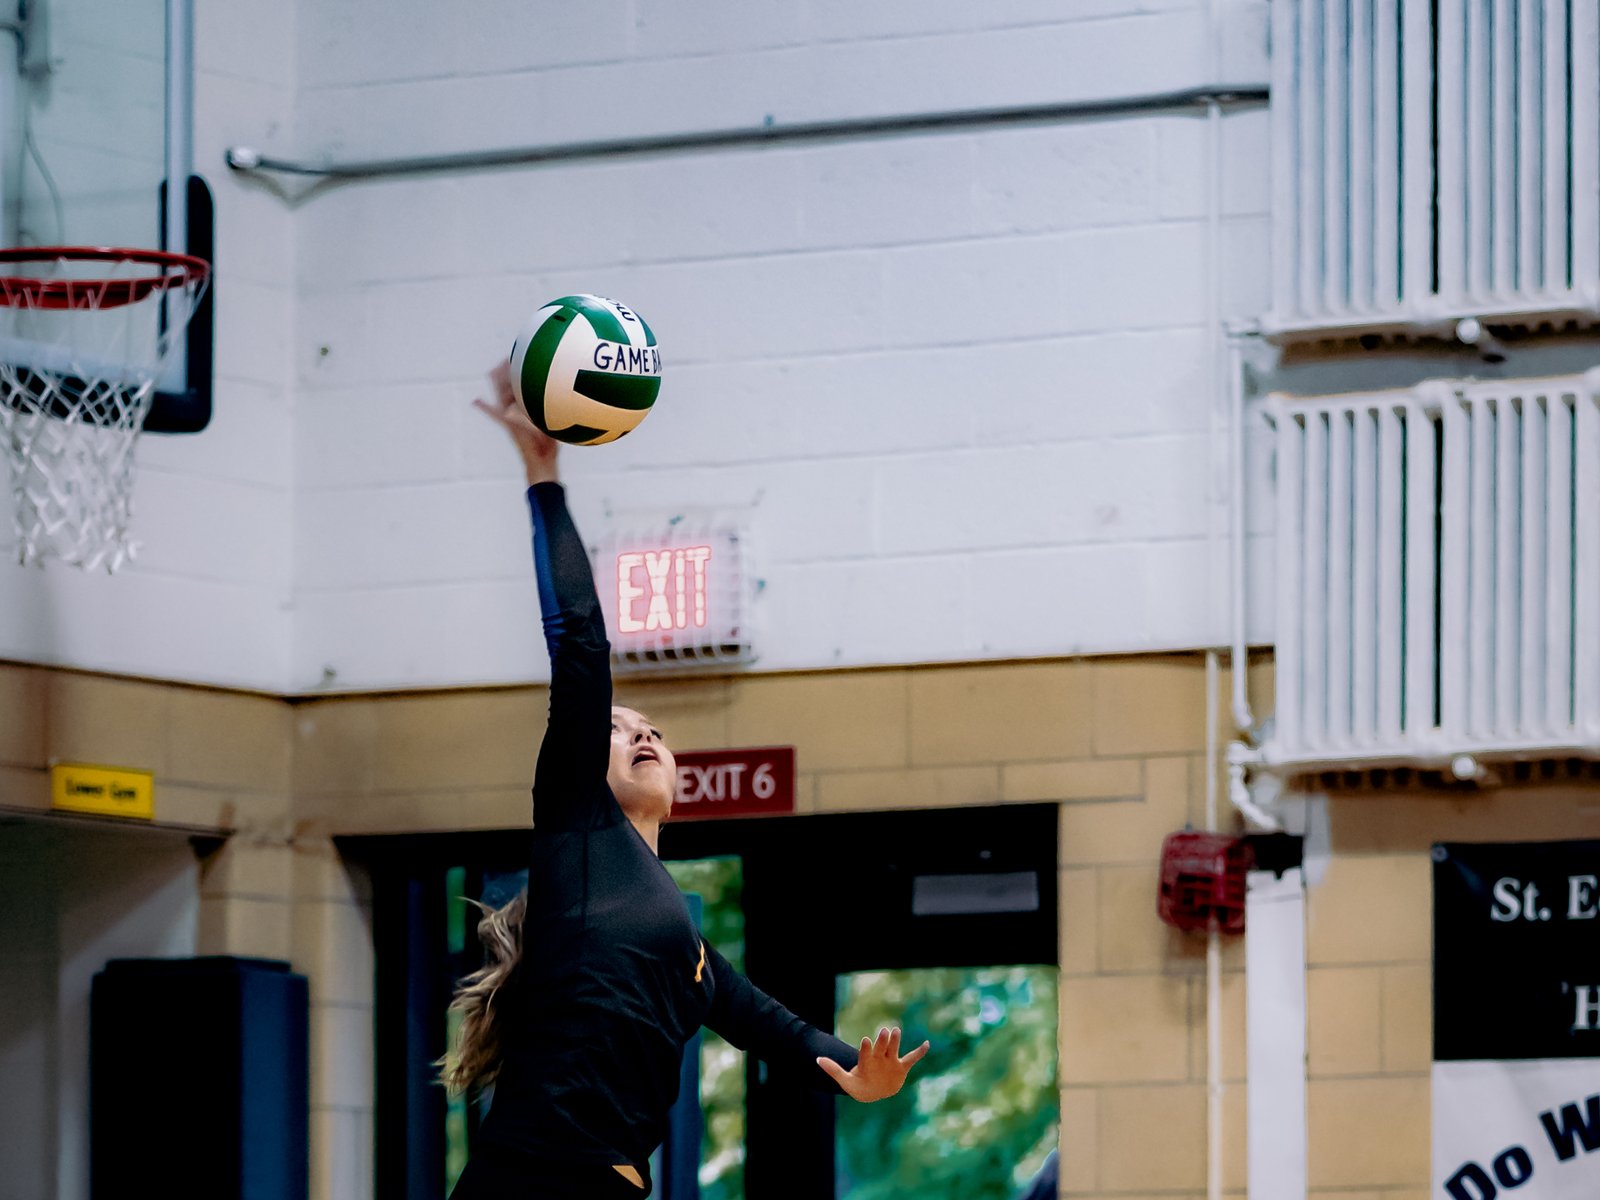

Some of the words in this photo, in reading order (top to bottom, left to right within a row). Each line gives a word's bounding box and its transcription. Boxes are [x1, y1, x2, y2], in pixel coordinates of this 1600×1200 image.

[594, 342, 650, 374] GAME
[617, 546, 711, 633] EXIT
[675, 763, 748, 804] EXIT
[752, 763, 776, 799] 6
[1491, 876, 1552, 922] St.
[1567, 874, 1600, 920] E
